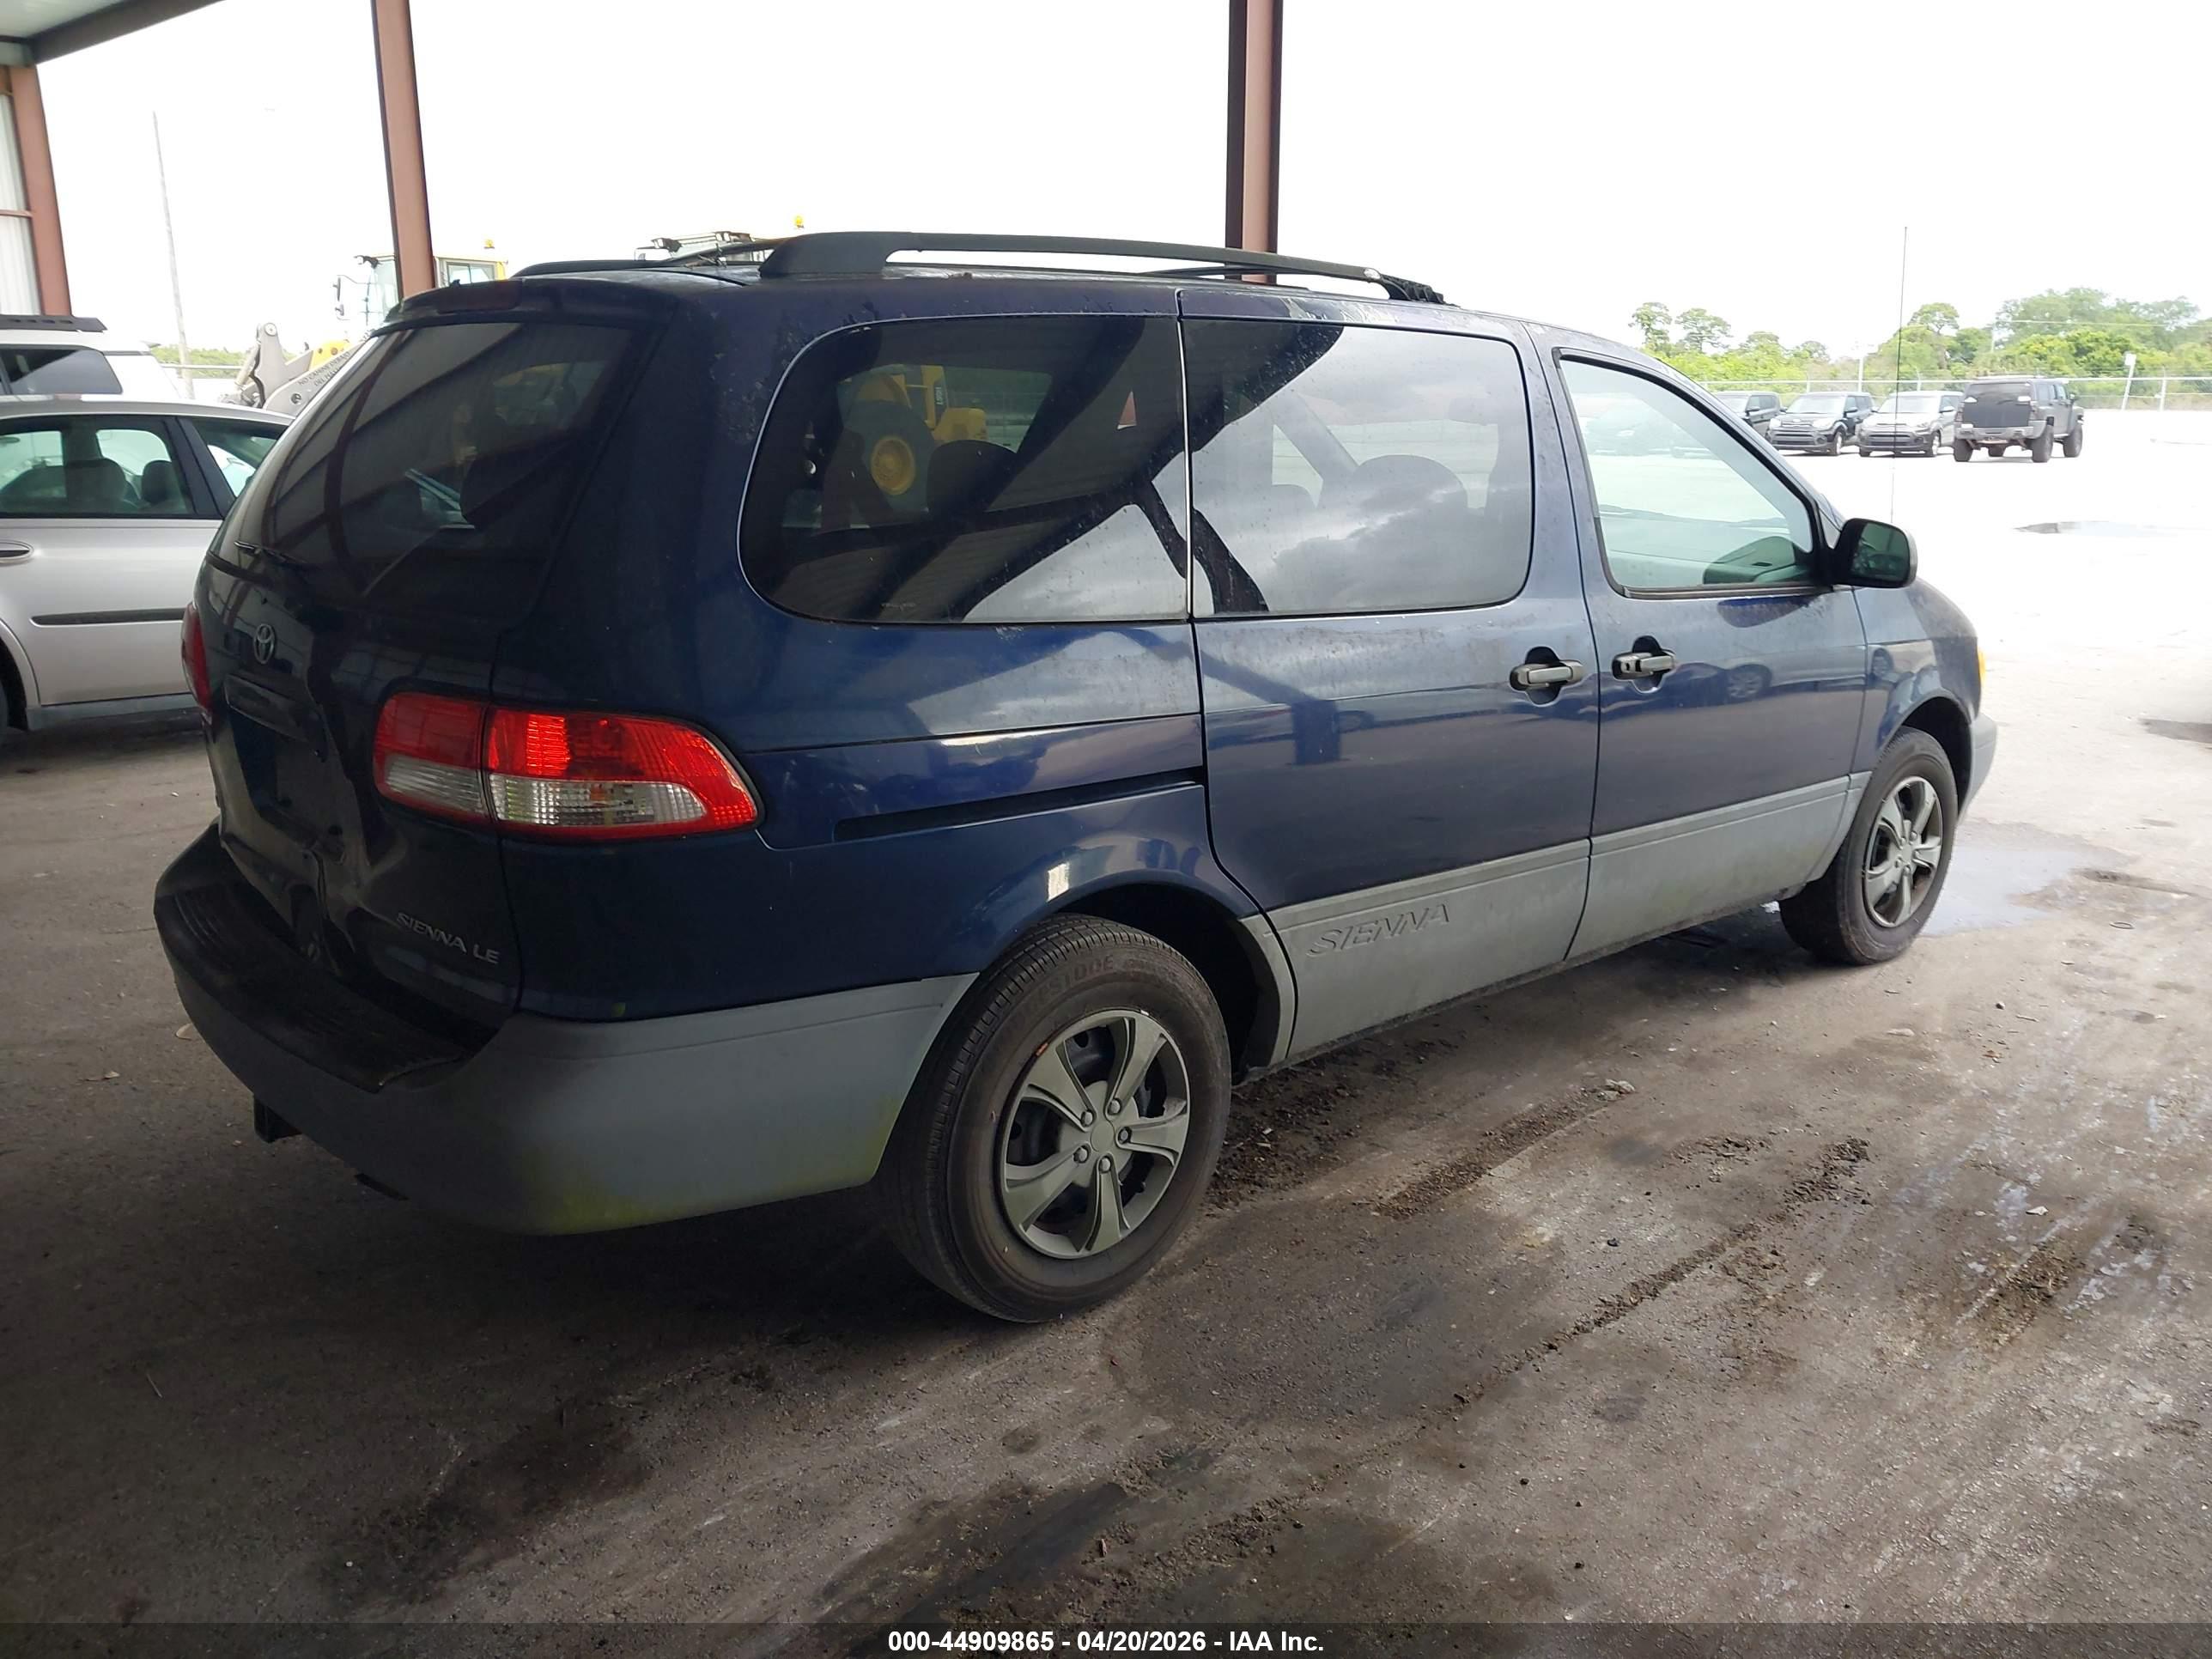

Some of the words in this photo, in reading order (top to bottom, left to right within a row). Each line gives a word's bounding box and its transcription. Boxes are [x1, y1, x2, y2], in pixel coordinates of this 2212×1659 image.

[396, 912, 468, 953] SIENNA
[473, 944, 500, 964] LE
[1305, 903, 1450, 957] SIENNA
